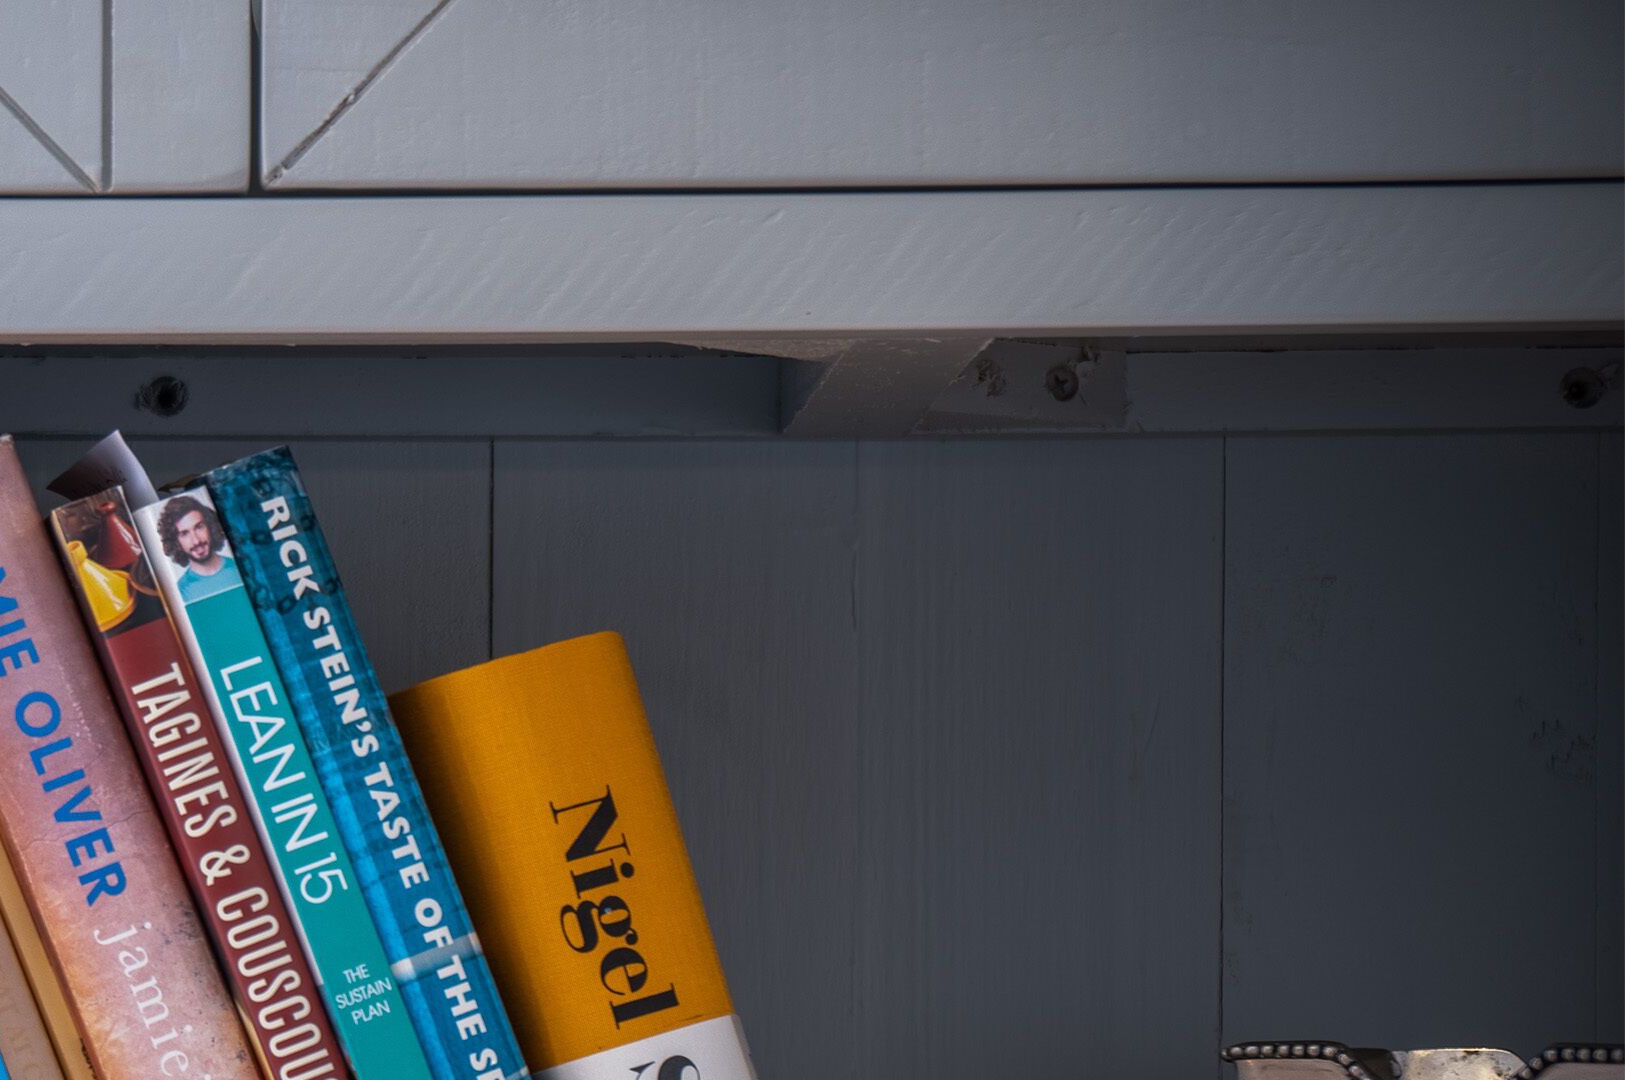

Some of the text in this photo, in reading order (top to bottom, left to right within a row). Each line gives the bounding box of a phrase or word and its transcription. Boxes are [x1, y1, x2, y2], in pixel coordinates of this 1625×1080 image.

[15, 690, 127, 908] OLIVER
[132, 662, 237, 838] TAGINES
[199, 843, 251, 885] &
[220, 656, 348, 904] LEAN IN 15
[261, 495, 320, 600] RICK
[363, 762, 430, 889] TASTE
[415, 899, 454, 950] OF
[435, 956, 487, 1040] THE
[335, 977, 392, 1010] SUSTAIN
[342, 964, 370, 984] THE
[351, 999, 391, 1025] PLAN
[548, 785, 680, 1030] Nigel
